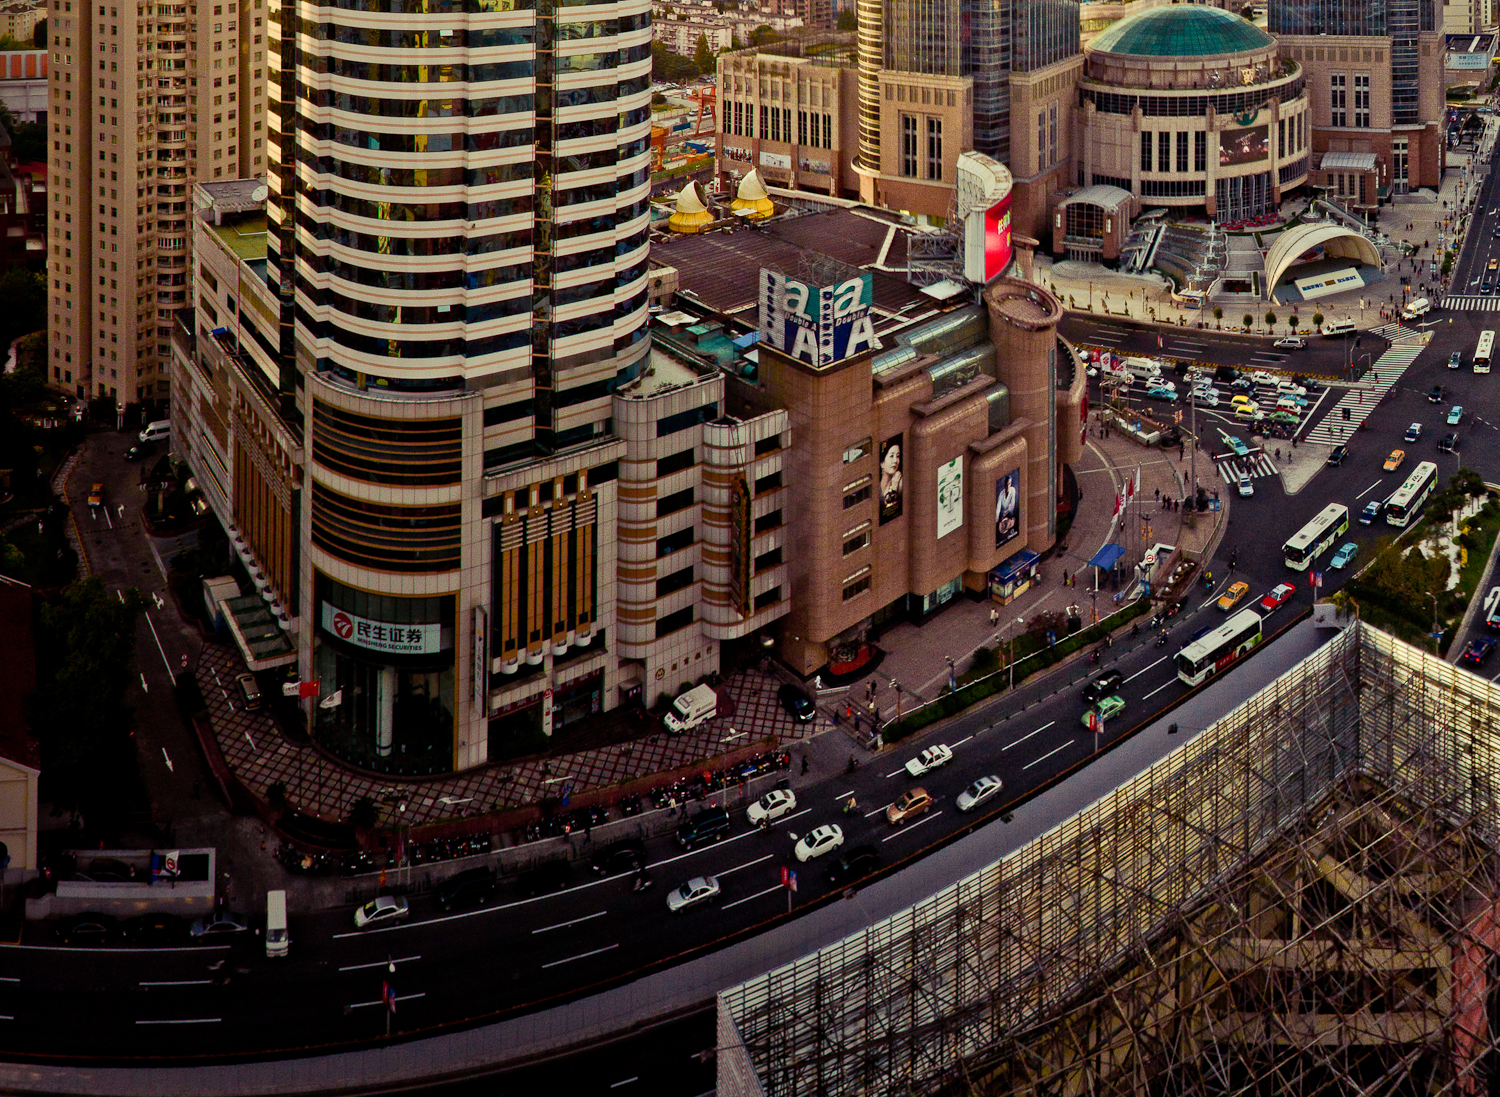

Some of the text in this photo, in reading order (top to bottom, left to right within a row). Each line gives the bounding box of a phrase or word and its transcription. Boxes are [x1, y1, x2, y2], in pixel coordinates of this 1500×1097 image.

[785, 311, 817, 332] Double A
[836, 306, 873, 327] Double A
[791, 326, 819, 368] A
[845, 315, 875, 358] A
[357, 621, 422, 643] 民生证券
[357, 637, 422, 651] MINSHENG SECURITIES
